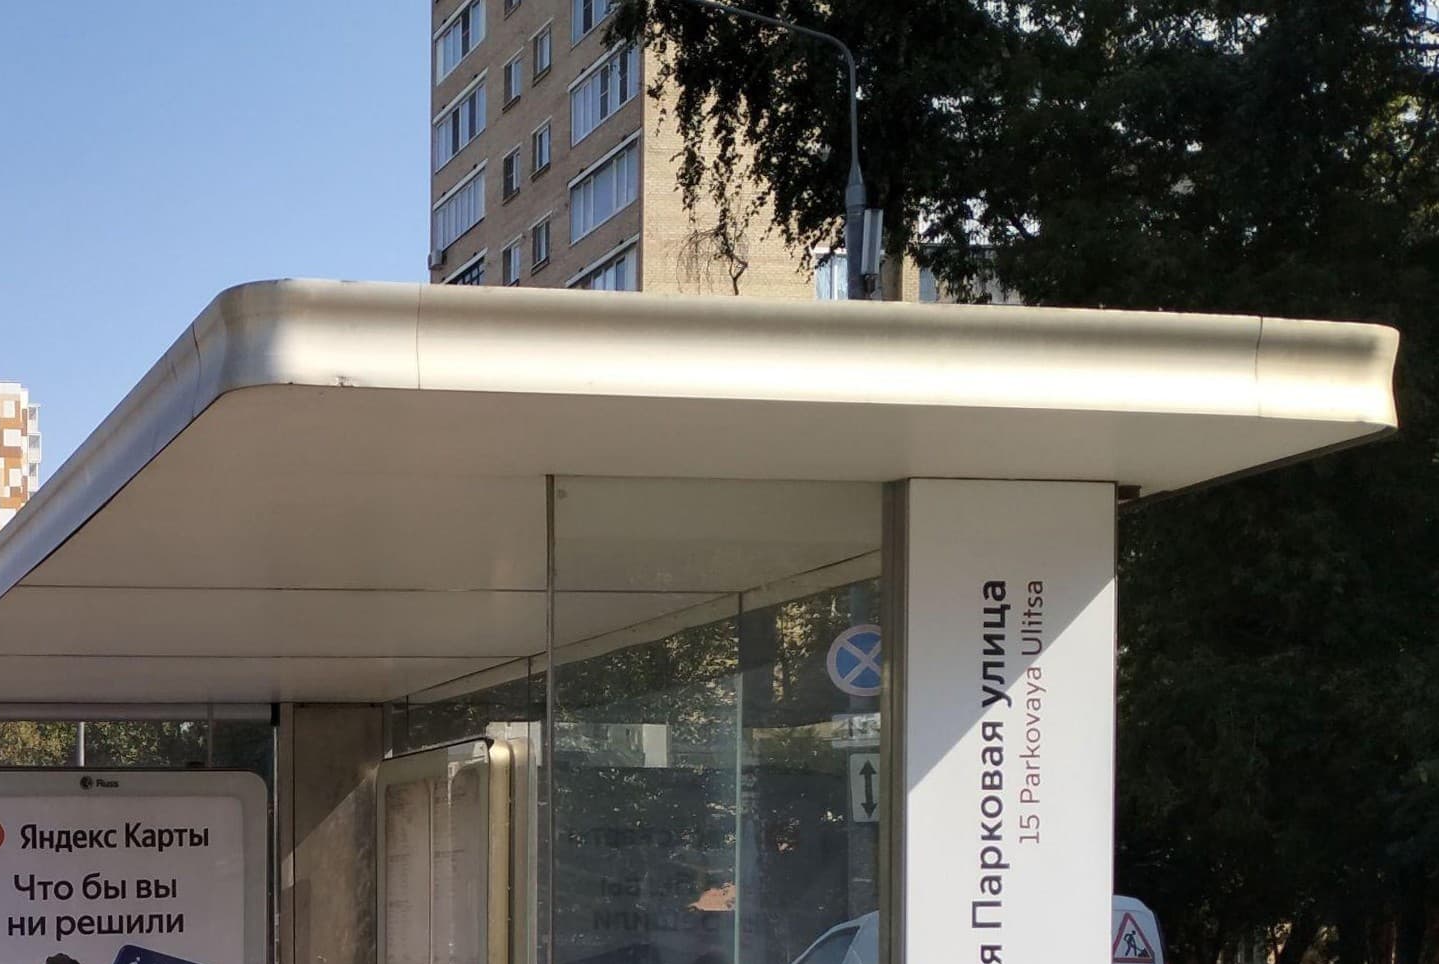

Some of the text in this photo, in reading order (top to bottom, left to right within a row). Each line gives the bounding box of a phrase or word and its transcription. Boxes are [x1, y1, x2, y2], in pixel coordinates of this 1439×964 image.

[981, 580, 1012, 708] улица
[1019, 580, 1047, 844] 15 Parkovaya Ulitsa
[20, 823, 209, 852] Яндекс Карты
[971, 720, 1010, 929] Парковая
[13, 873, 177, 901] Что бы вы
[7, 913, 184, 941] ни решили
